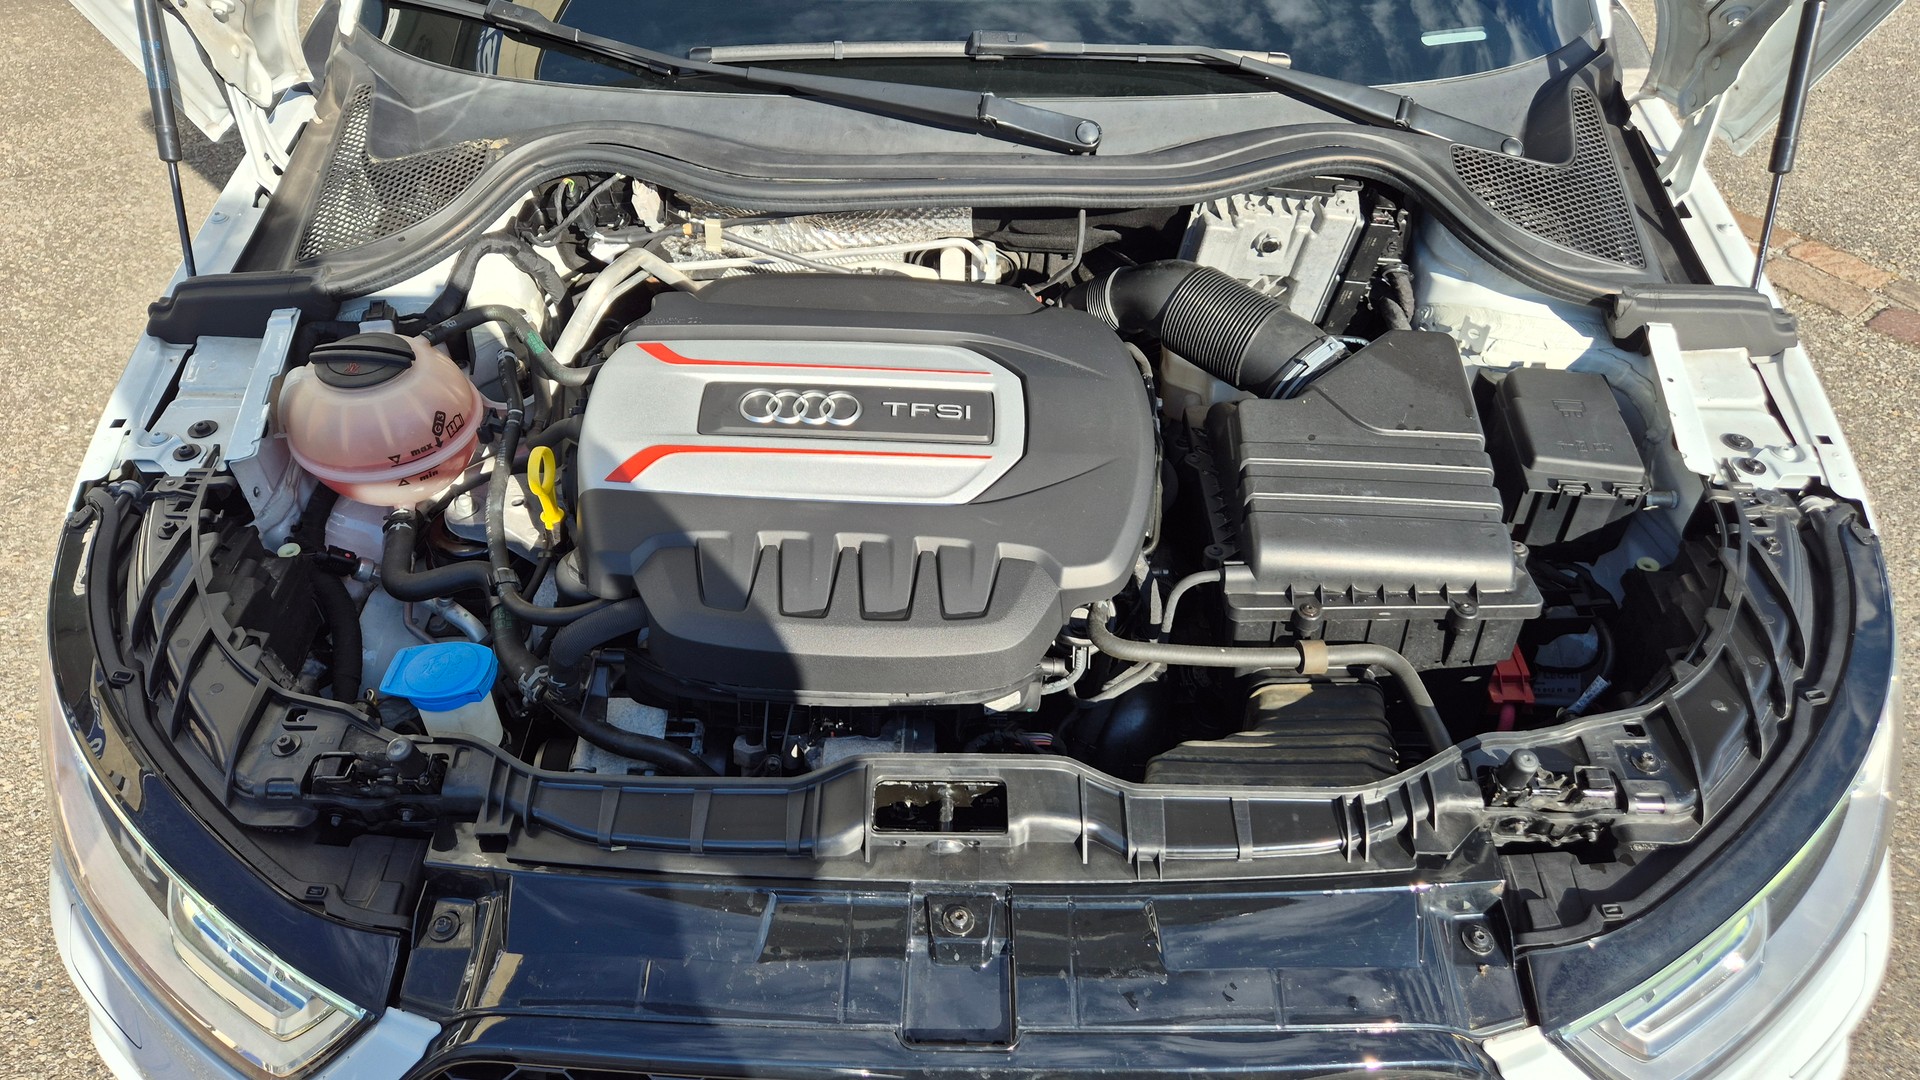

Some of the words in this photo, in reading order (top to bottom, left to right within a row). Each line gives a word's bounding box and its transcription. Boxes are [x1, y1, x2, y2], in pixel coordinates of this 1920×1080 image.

[882, 401, 971, 420] TFSI
[434, 413, 445, 433] G13
[410, 443, 433, 456] max
[419, 470, 438, 481] min
